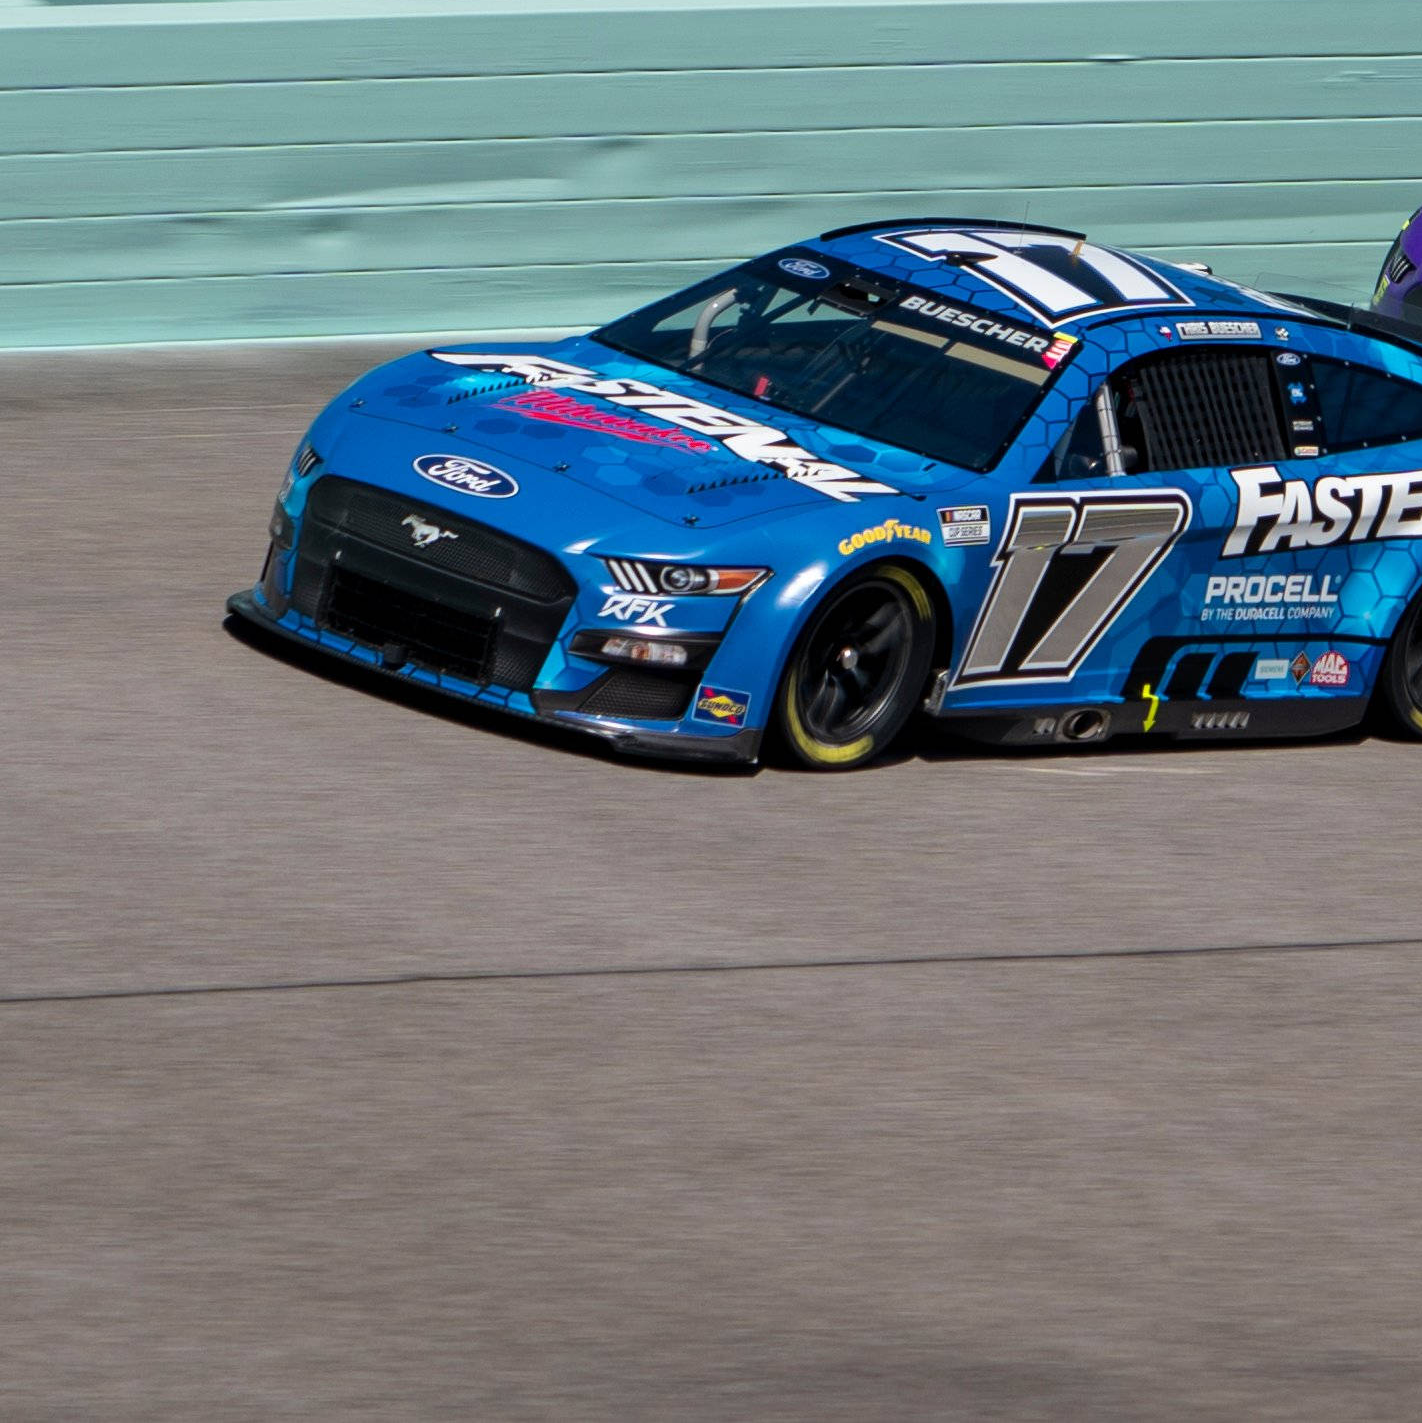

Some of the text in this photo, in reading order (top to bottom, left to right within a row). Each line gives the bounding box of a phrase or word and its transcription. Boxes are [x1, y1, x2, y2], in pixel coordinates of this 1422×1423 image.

[899, 296, 1049, 354] BUESCHER
[428, 352, 902, 503] FASTENAL
[426, 459, 502, 493] Ford
[952, 509, 982, 521] NASCAR
[838, 519, 932, 556] GOODYEAR
[948, 487, 1193, 692] 17
[1204, 575, 1338, 604] PROCELL
[597, 594, 675, 627] RFK
[1201, 606, 1335, 621] BY THE DURACELL COMPANY
[1312, 674, 1347, 684] TOOLS
[1313, 652, 1347, 675] MAC
[699, 698, 746, 715] SUNOCO
